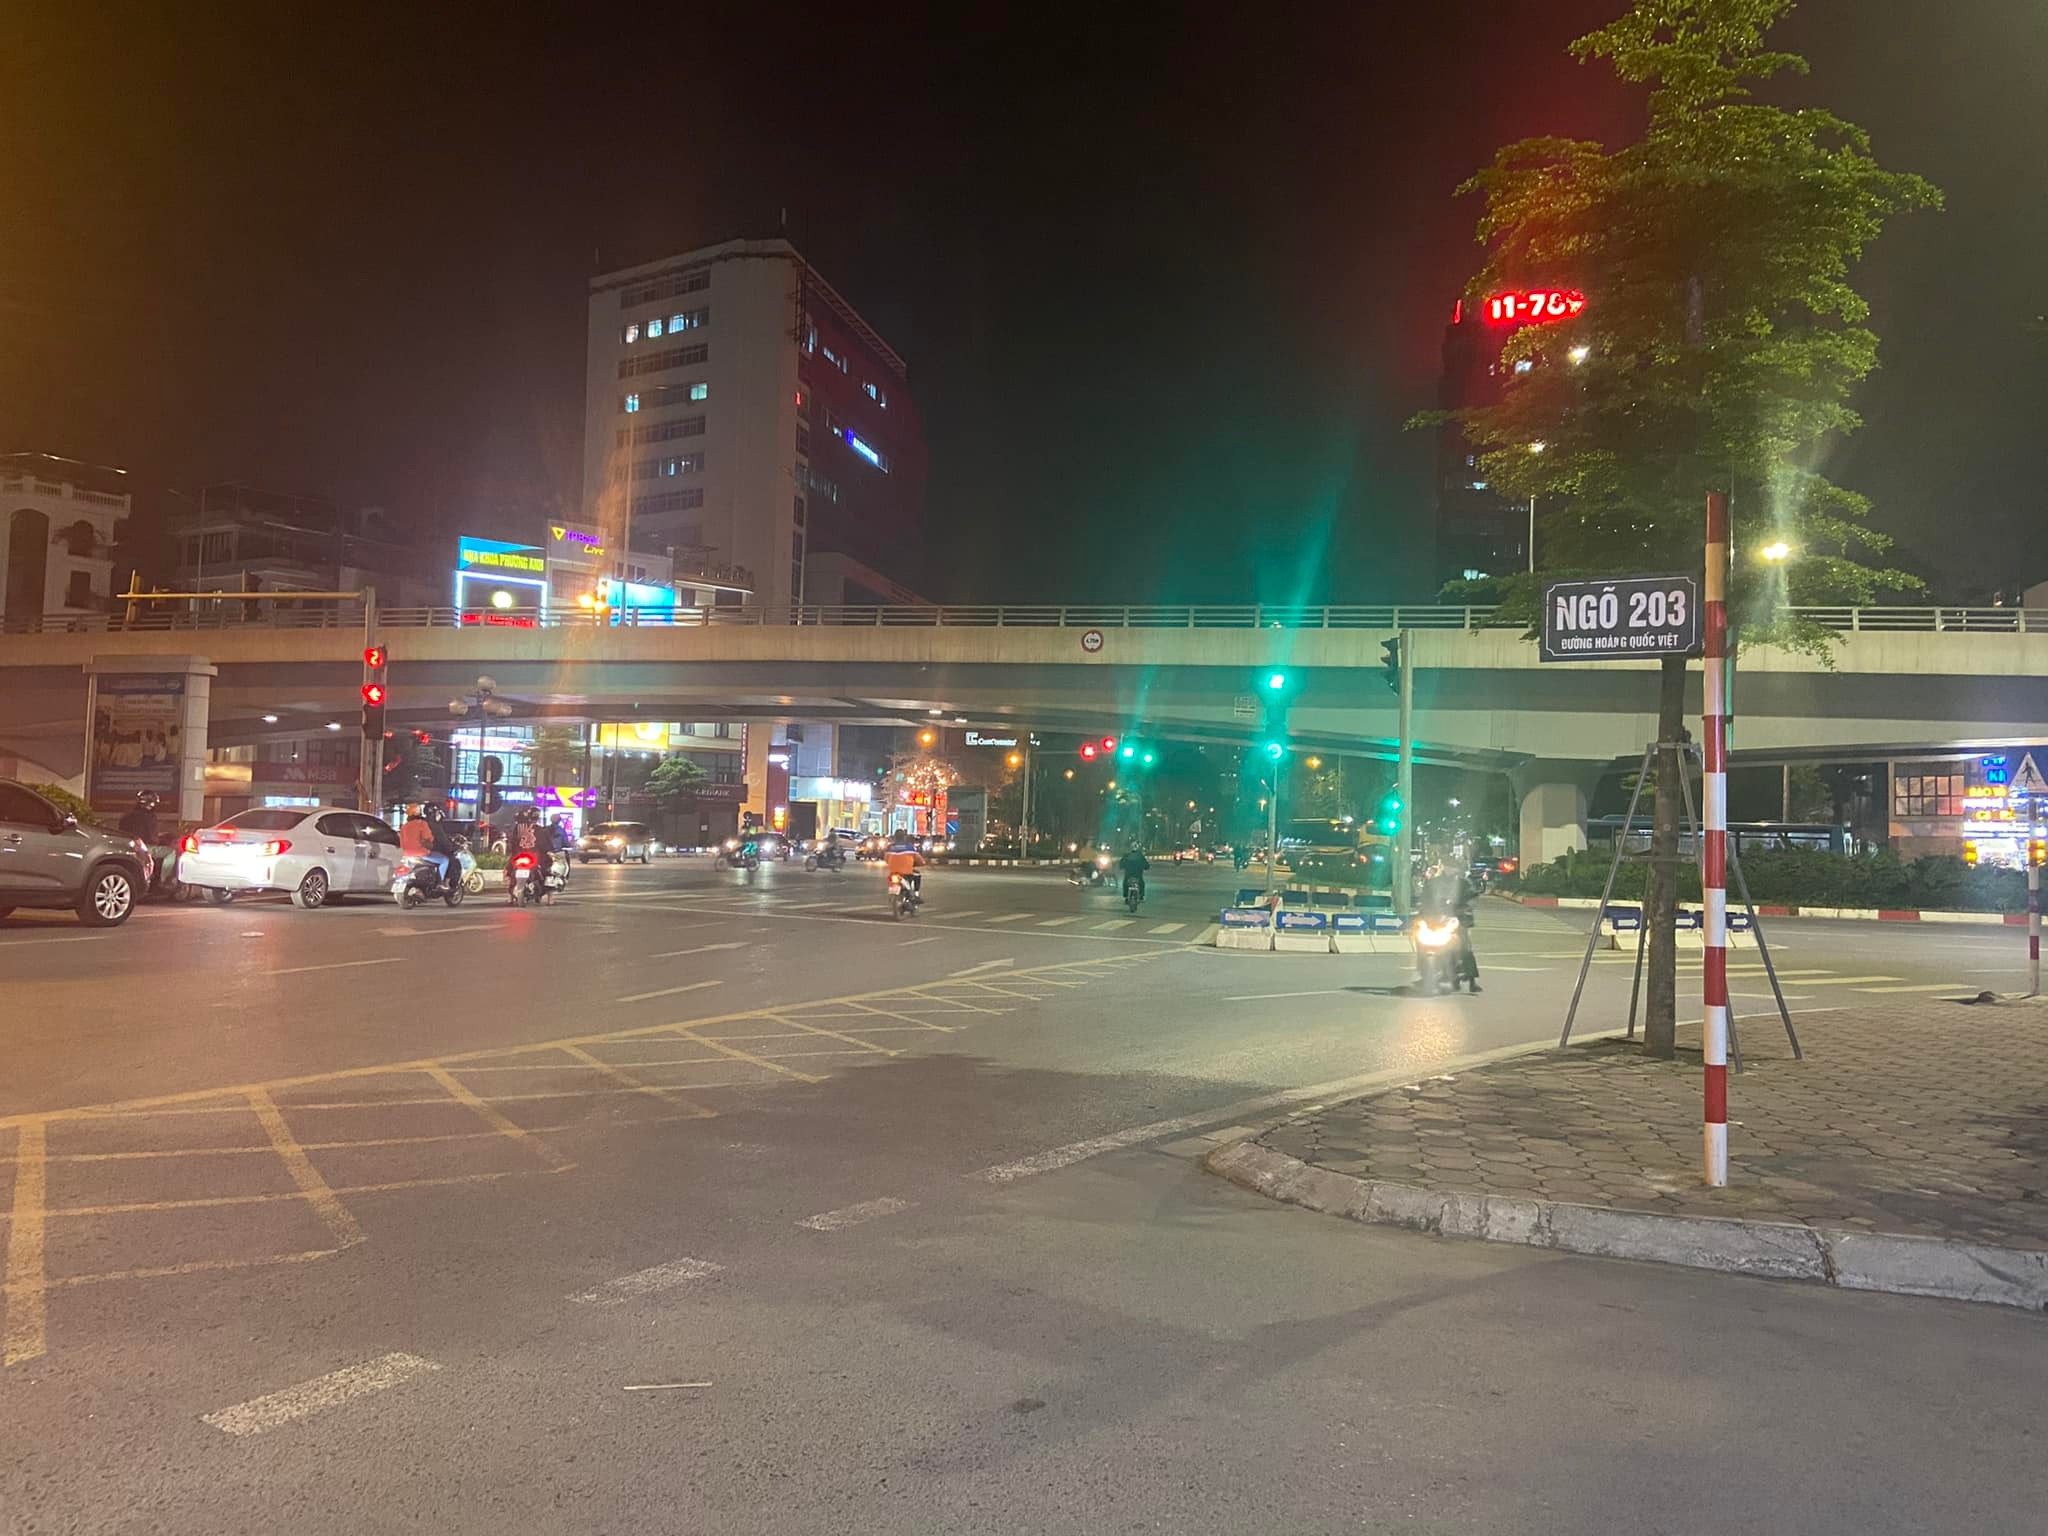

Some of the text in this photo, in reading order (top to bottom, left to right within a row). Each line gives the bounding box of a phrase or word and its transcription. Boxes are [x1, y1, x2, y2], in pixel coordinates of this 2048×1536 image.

[1556, 586, 1686, 631] NGÕ 203
[1629, 631, 1656, 648] QUỐC
[1657, 631, 1679, 648] VIỆT
